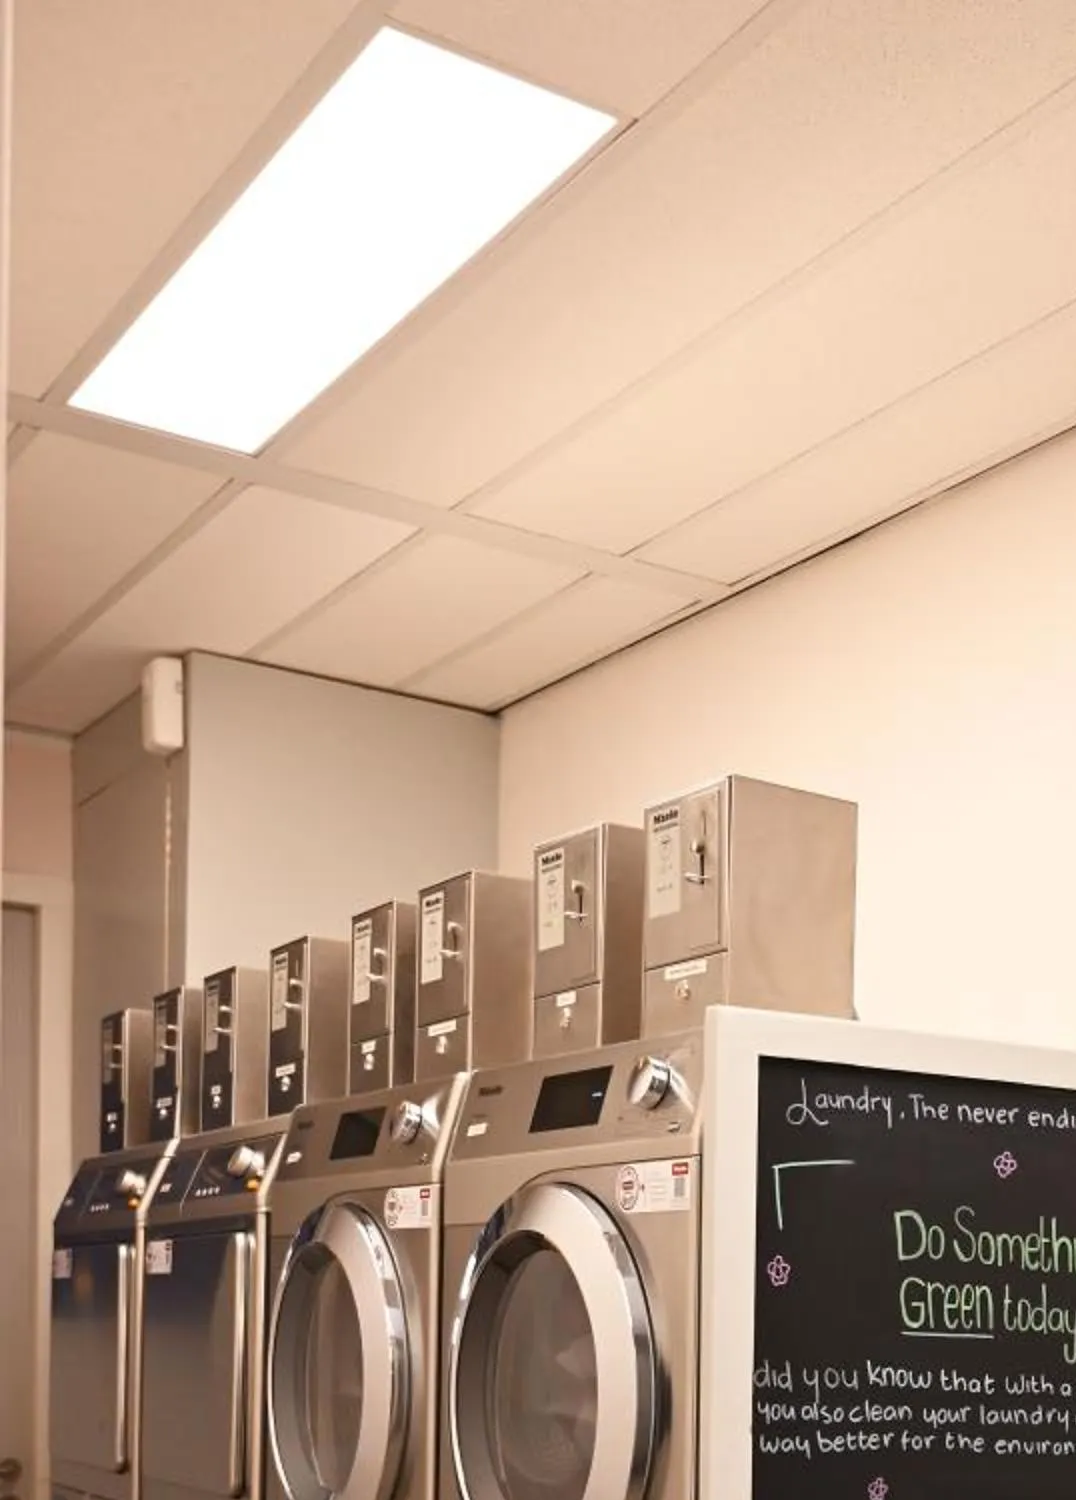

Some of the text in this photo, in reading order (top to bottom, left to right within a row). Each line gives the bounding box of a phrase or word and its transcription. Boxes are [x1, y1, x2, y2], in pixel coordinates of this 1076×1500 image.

[908, 1093, 950, 1121] The
[957, 1103, 1019, 1125] never
[894, 1209, 946, 1261] Do
[900, 1276, 994, 1330] Green
[753, 1359, 793, 1393] did
[803, 1367, 859, 1404] you
[866, 1359, 932, 1388] know
[940, 1369, 996, 1394] that
[1060, 1383, 1073, 1397] a
[757, 1400, 797, 1425] you
[801, 1401, 846, 1425] also
[849, 1399, 913, 1423] clean
[923, 1405, 971, 1430] your
[979, 1404, 1069, 1434] laundry
[758, 1433, 812, 1461] way
[815, 1428, 896, 1453] better
[901, 1429, 937, 1451] for
[944, 1430, 985, 1453] the
